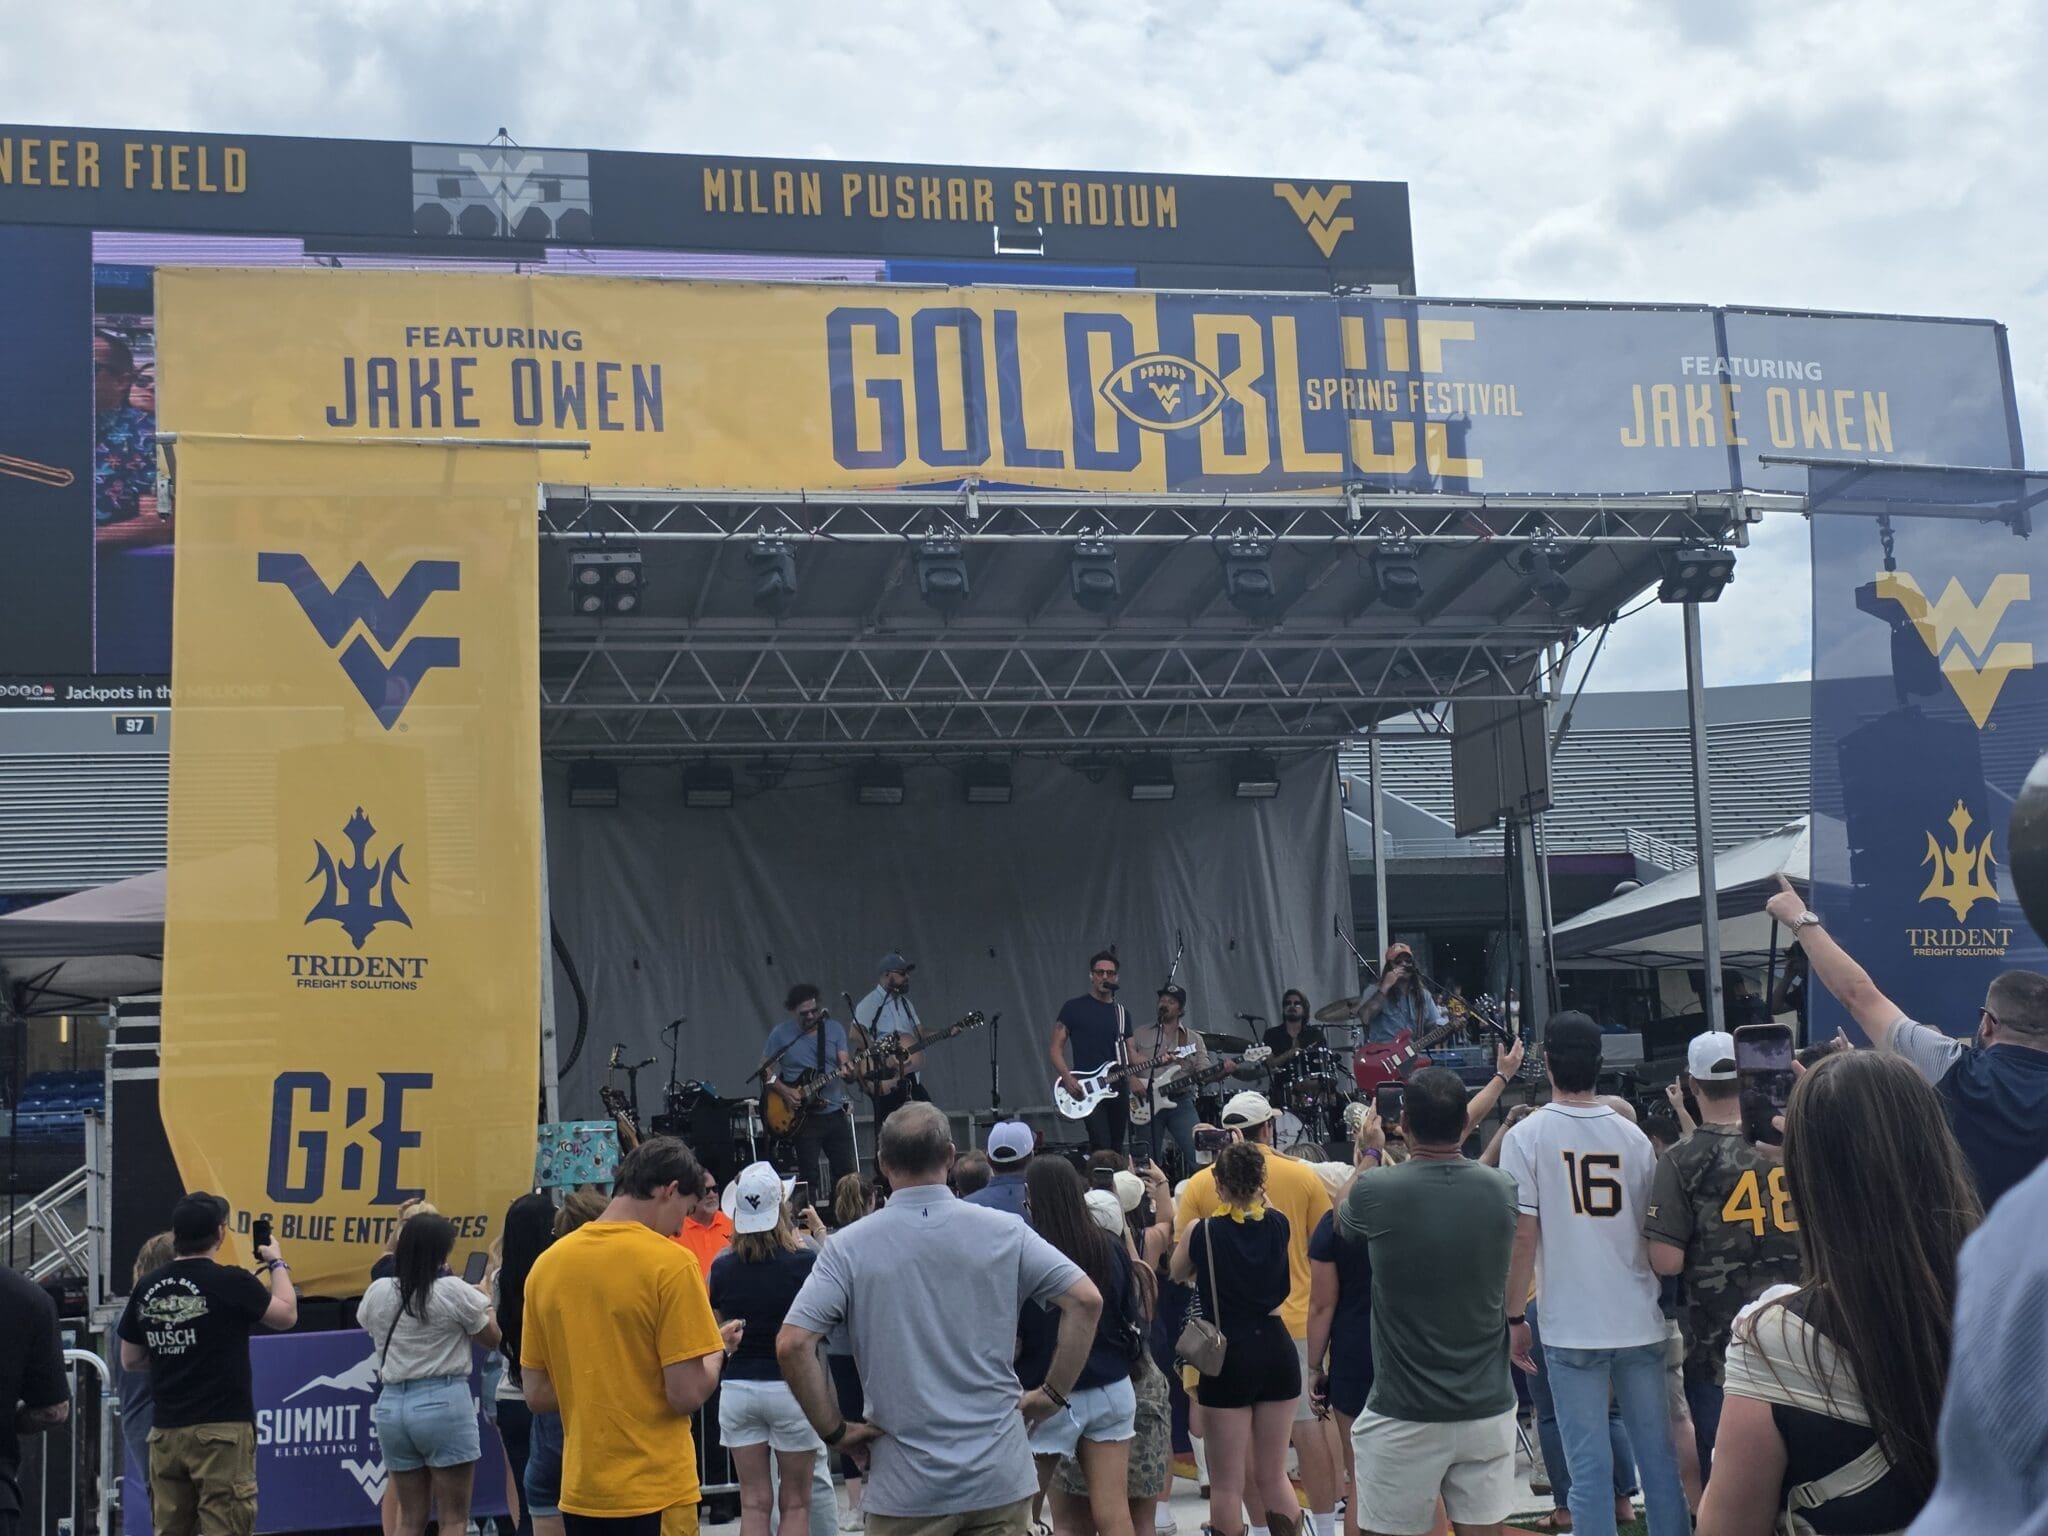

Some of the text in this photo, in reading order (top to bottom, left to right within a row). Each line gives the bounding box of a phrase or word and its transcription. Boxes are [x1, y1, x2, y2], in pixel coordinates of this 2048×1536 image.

[125, 143, 247, 193] FIELD
[703, 168, 1177, 229] MILAN PUSKAR STADIUM
[405, 326, 583, 351] FEATURING
[1681, 356, 1822, 381] FEATURING
[325, 357, 664, 432] JAKE OWEN
[825, 306, 1484, 480] GOLD BLUE
[1306, 378, 1398, 412] SPRING
[1408, 380, 1523, 417] FESTIVAL
[1620, 383, 1894, 452] JAKE OWEN
[66, 685, 134, 702] Jackpots
[138, 685, 153, 699] in
[156, 685, 173, 699] th
[126, 719, 144, 732] 97
[1905, 928, 2013, 947] TRIDENT
[1913, 947, 2006, 957] FREIGHT SOLUTIONS
[287, 954, 428, 979] TRIDENT
[297, 979, 417, 991] FREIGHT SOLUTIONS
[1562, 1150, 1622, 1218] 16
[281, 1214, 337, 1242] BLUE
[145, 1328, 197, 1347] BUSCH
[158, 1345, 186, 1354] LIGHT
[256, 1404, 361, 1445] SUMMIT
[275, 1443, 358, 1457] ELEVATING
